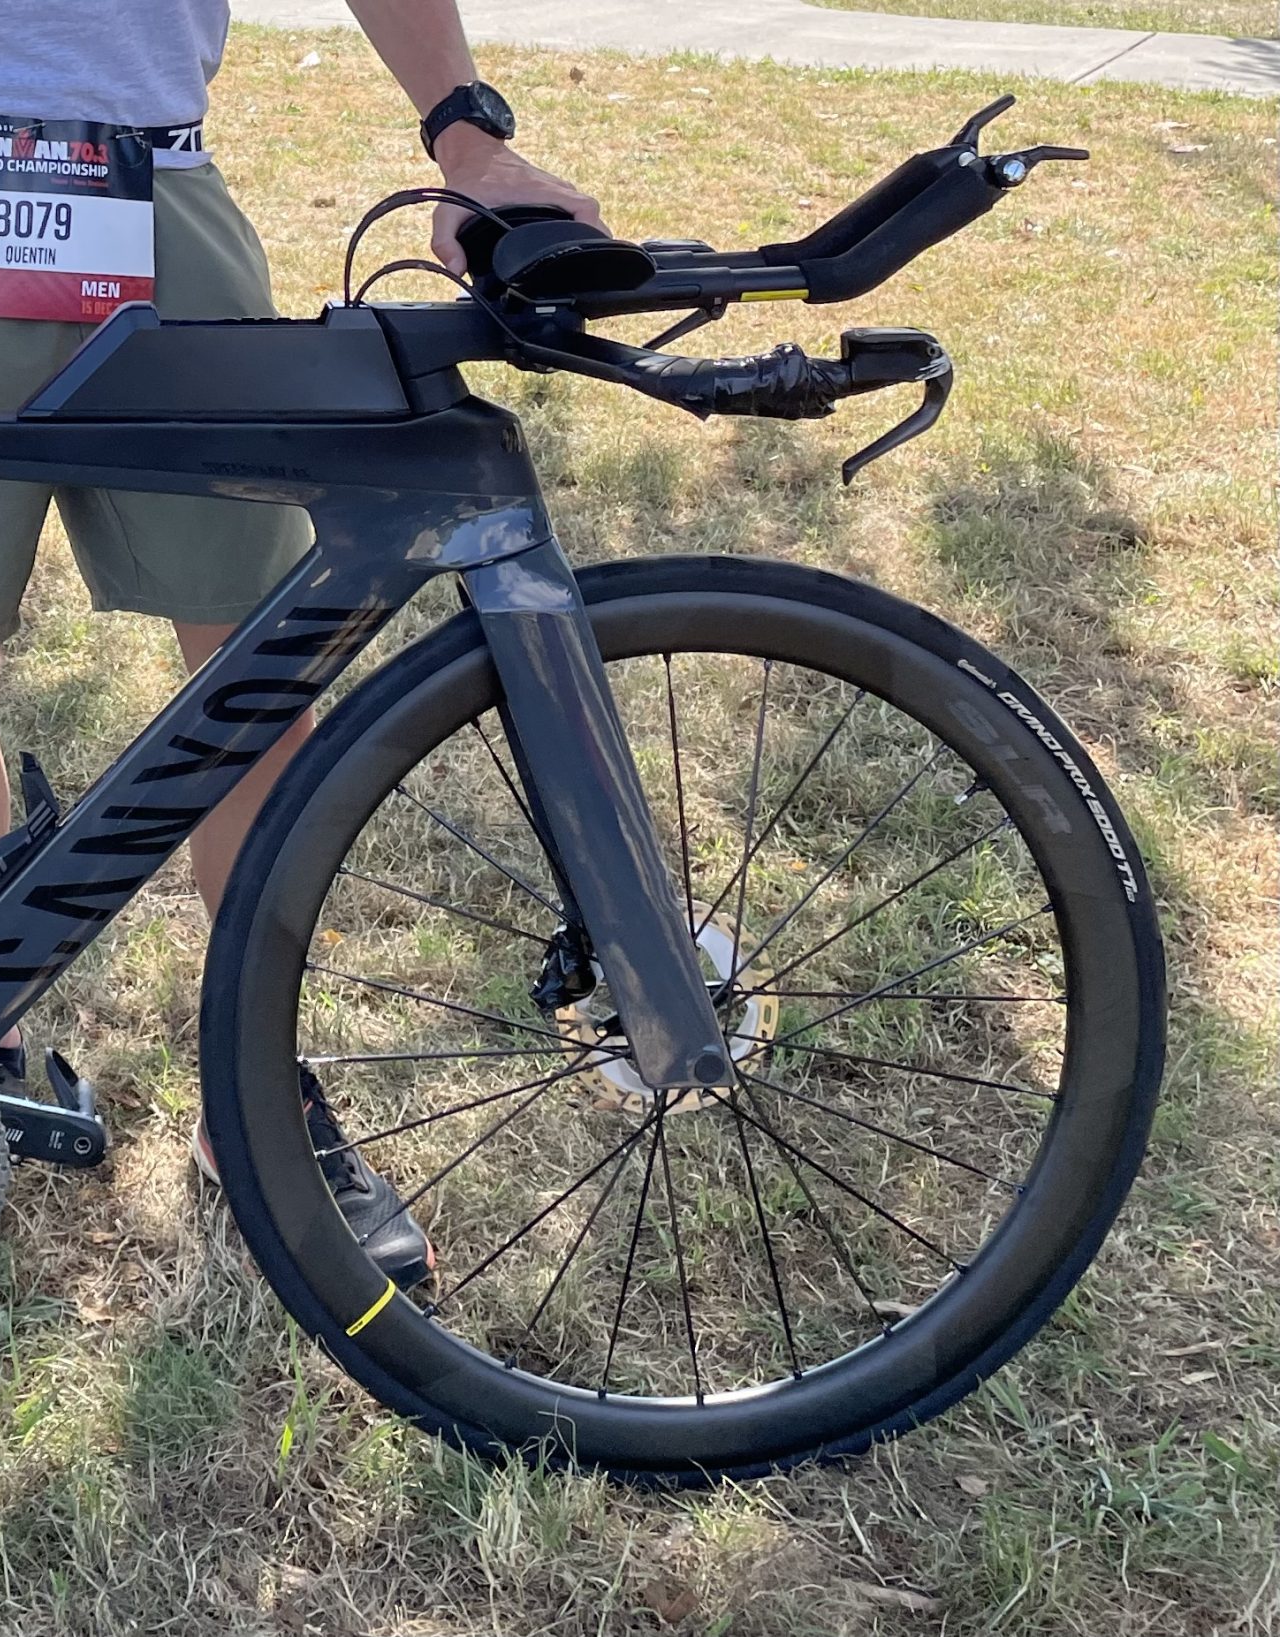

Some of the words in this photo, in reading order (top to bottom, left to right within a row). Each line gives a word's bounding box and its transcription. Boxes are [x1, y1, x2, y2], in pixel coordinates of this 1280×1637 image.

[70, 141, 109, 164] 70.3
[7, 159, 109, 178] CHAMPIONSHIP
[5, 245, 57, 266] QUENTIN
[81, 280, 121, 299] MEN
[945, 698, 1072, 835] SLR
[997, 691, 1064, 751] GRAND
[1053, 750, 1097, 799] PRIX
[1086, 799, 1127, 860] 5000
